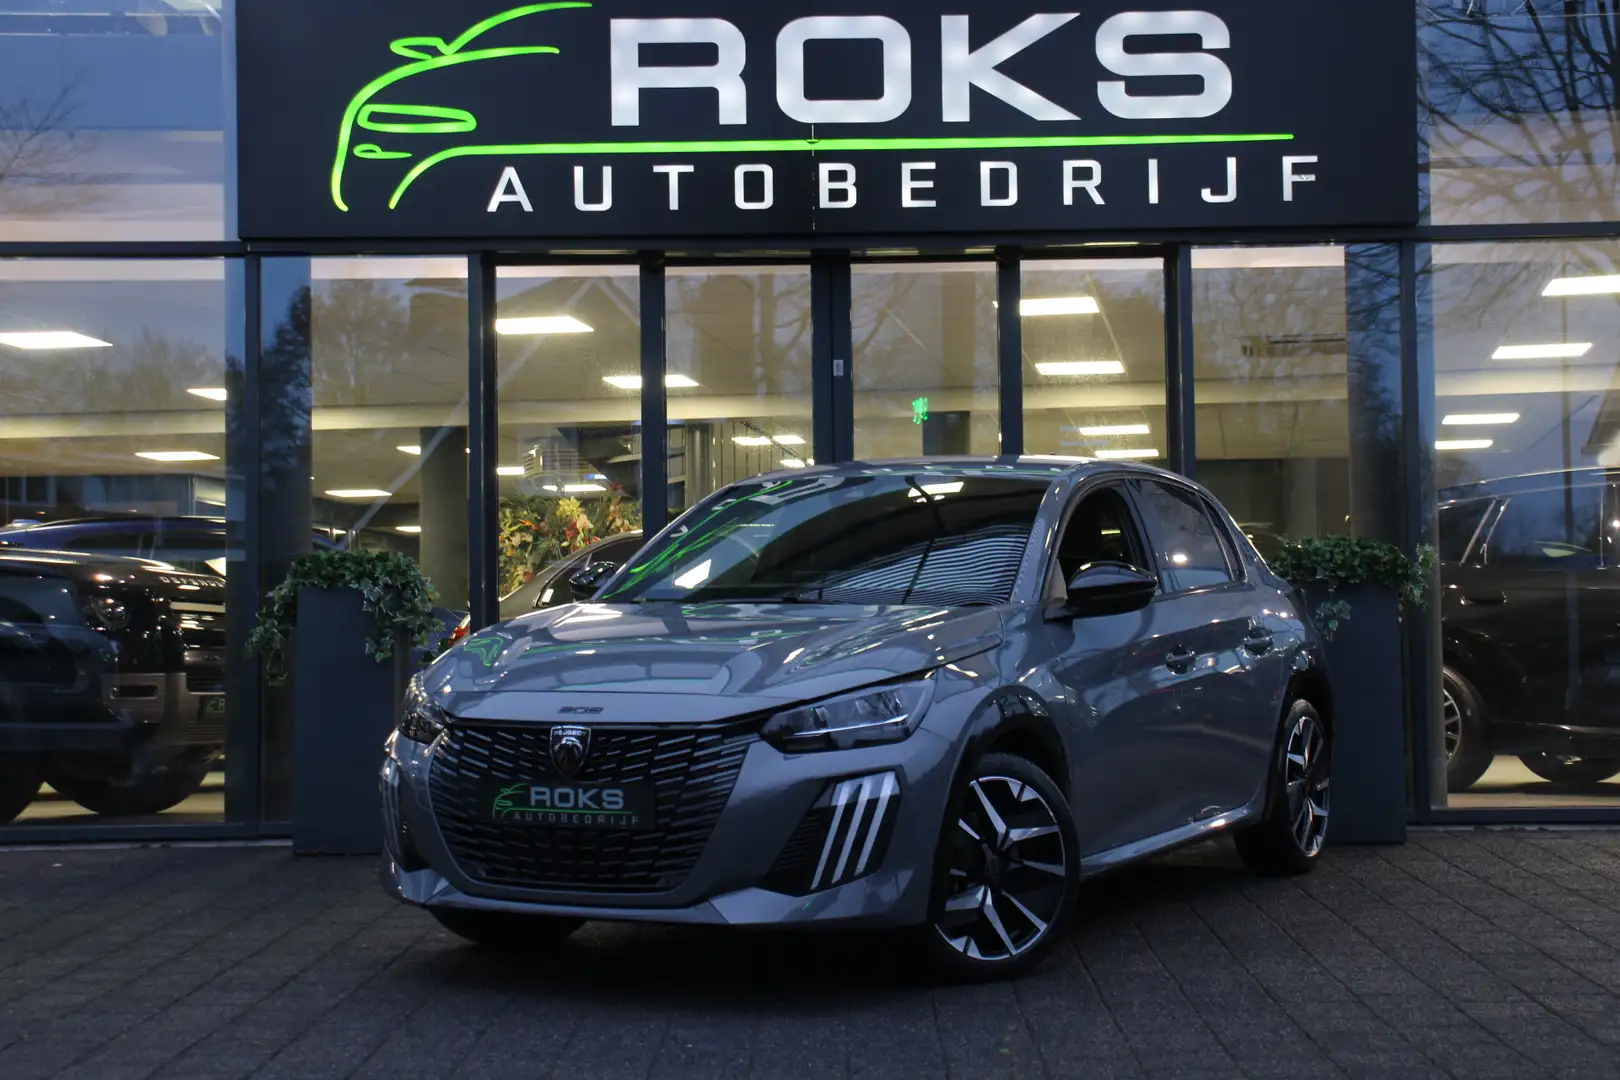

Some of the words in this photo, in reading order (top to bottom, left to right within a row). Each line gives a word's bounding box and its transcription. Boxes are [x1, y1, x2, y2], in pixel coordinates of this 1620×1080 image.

[610, 10, 1232, 126] ROKS
[487, 155, 1319, 212] AUTOBEDRIJF
[159, 576, 226, 587] DEFENDE
[530, 786, 624, 809] ROKS
[513, 812, 640, 825] AUTOBEDRIJF
